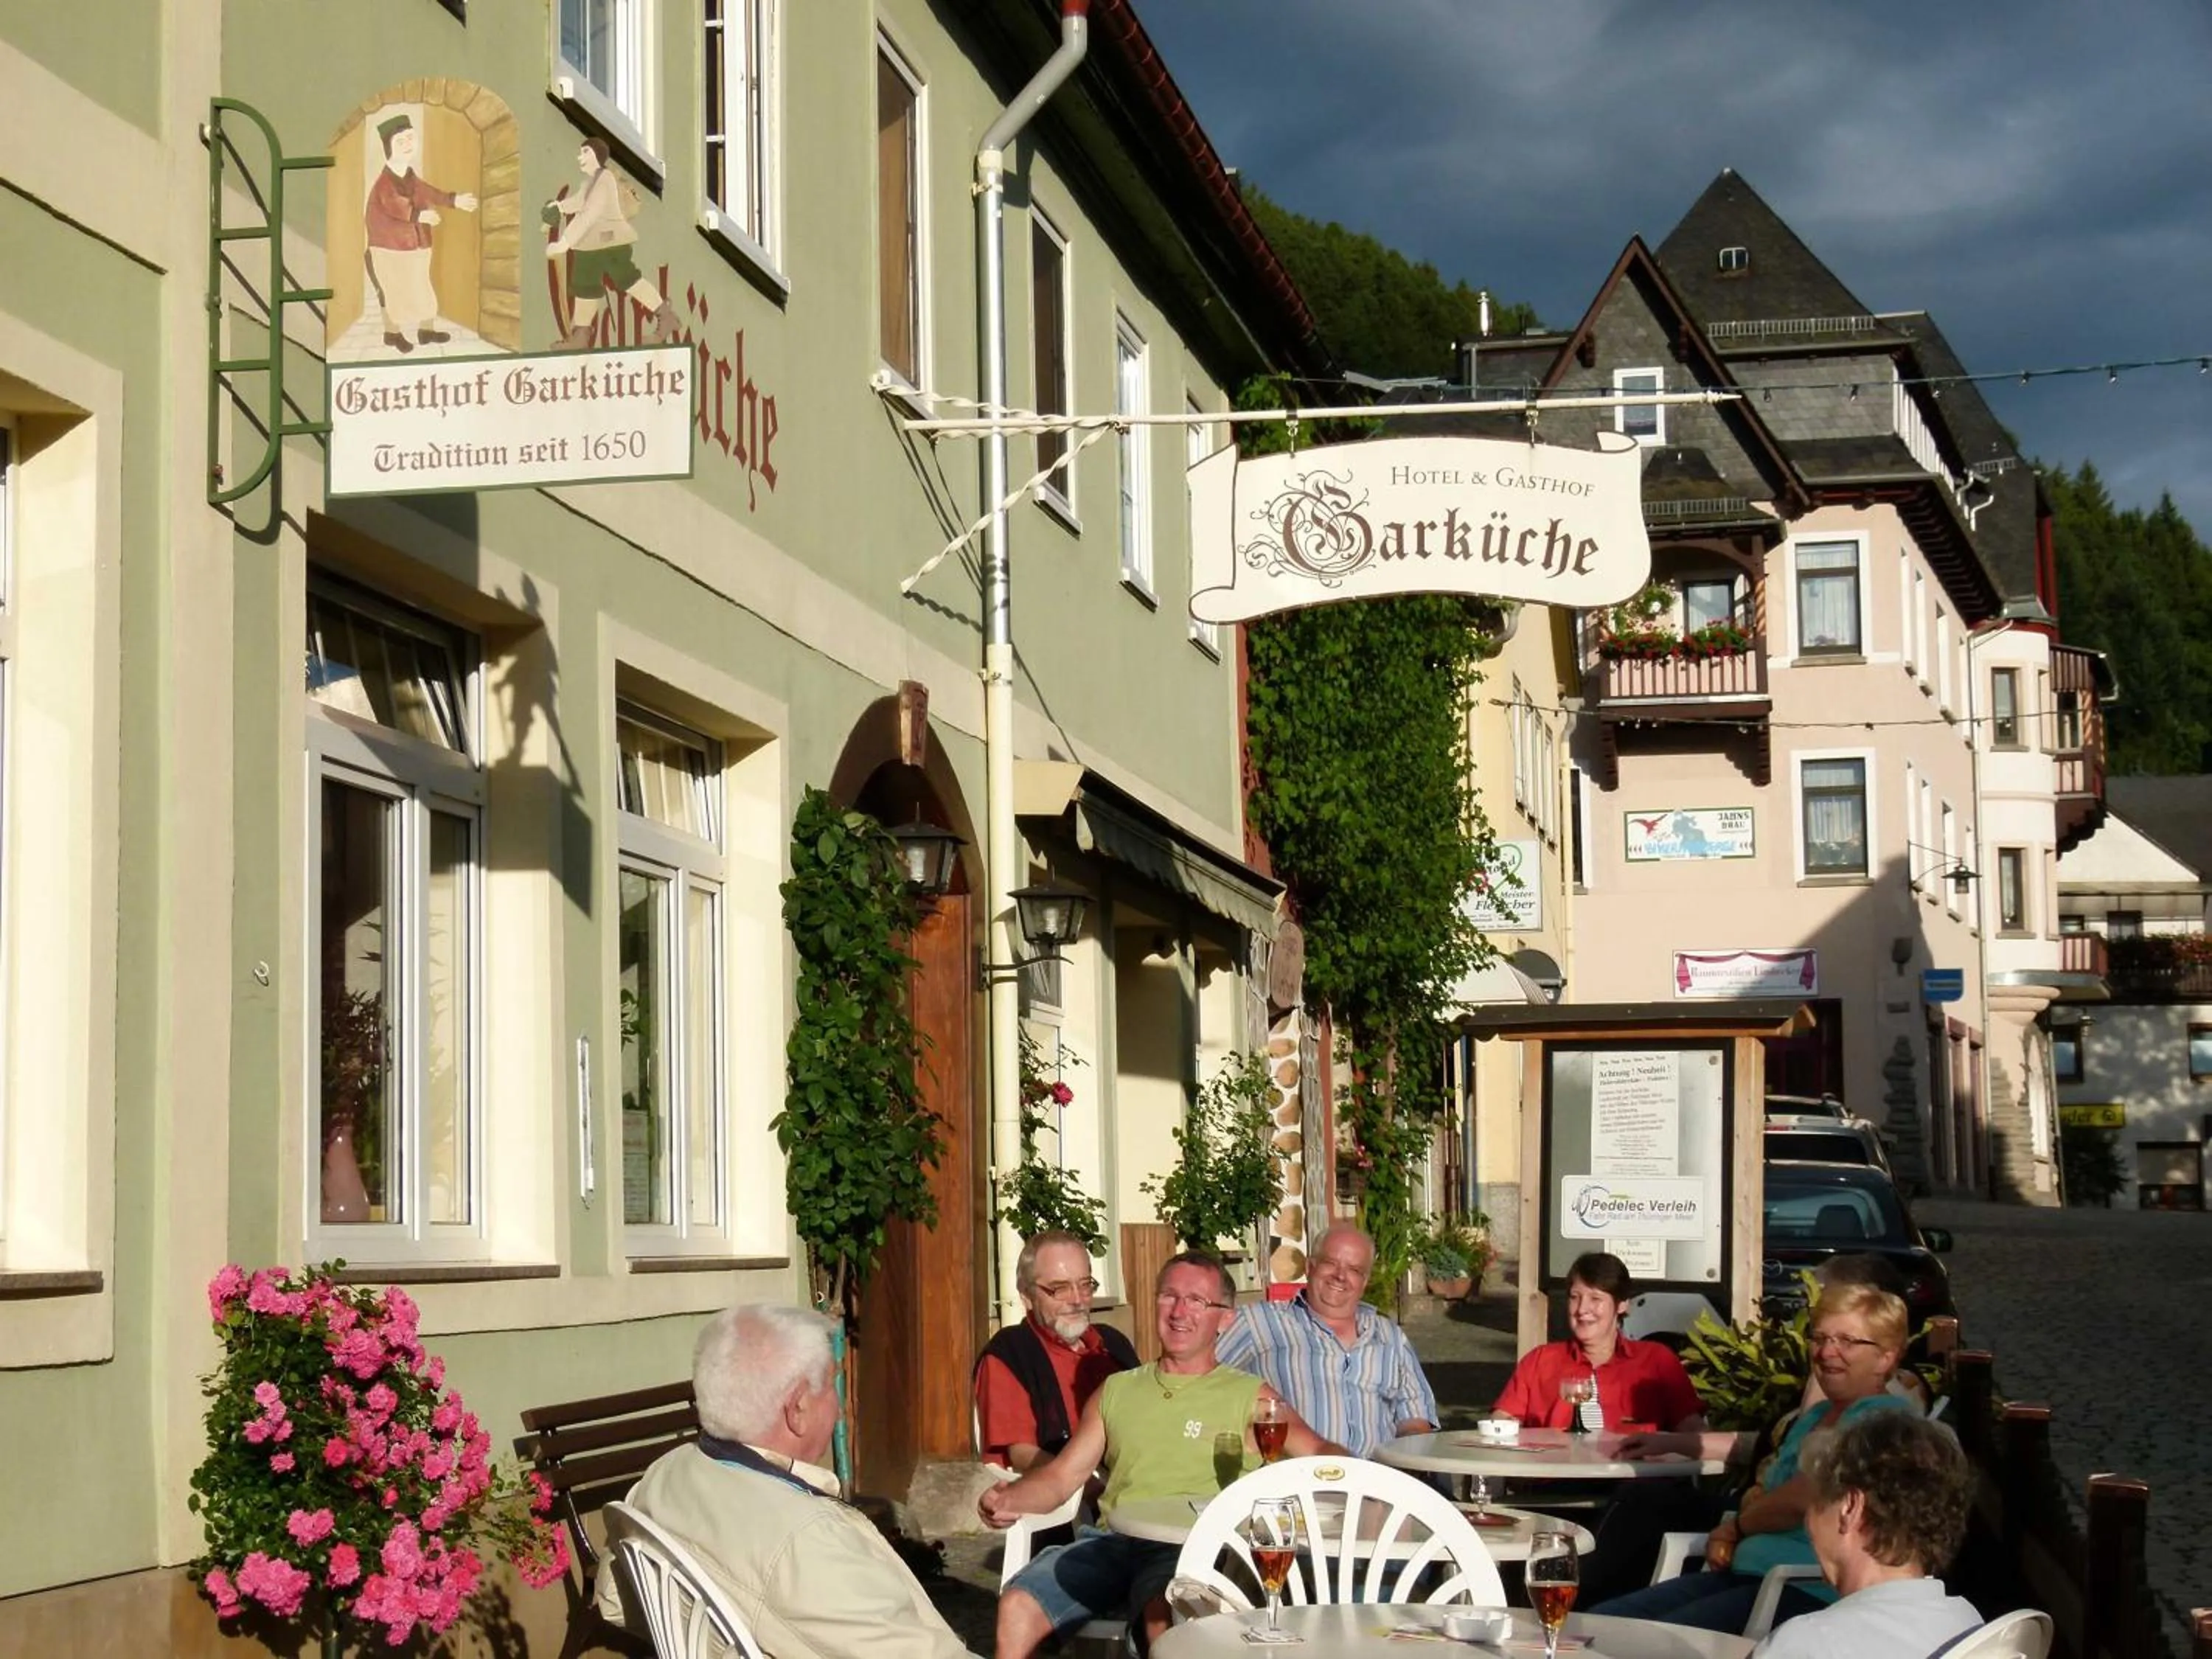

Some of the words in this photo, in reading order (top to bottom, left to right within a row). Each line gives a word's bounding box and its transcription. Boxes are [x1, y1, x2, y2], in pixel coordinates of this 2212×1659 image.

[335, 369, 493, 417] Gasthof
[504, 361, 685, 406] Garküche
[373, 442, 508, 473] Tradition
[518, 437, 569, 465] seit
[582, 430, 647, 462] 1650
[1391, 466, 1464, 486] HOTEL
[1472, 471, 1487, 486] &
[1495, 467, 1596, 498] GASTHOF
[1248, 472, 1599, 587] Garküche
[1590, 1199, 1644, 1211] Pedelec
[1649, 1200, 1697, 1212] Verleih
[1183, 1419, 1203, 1439] 99
